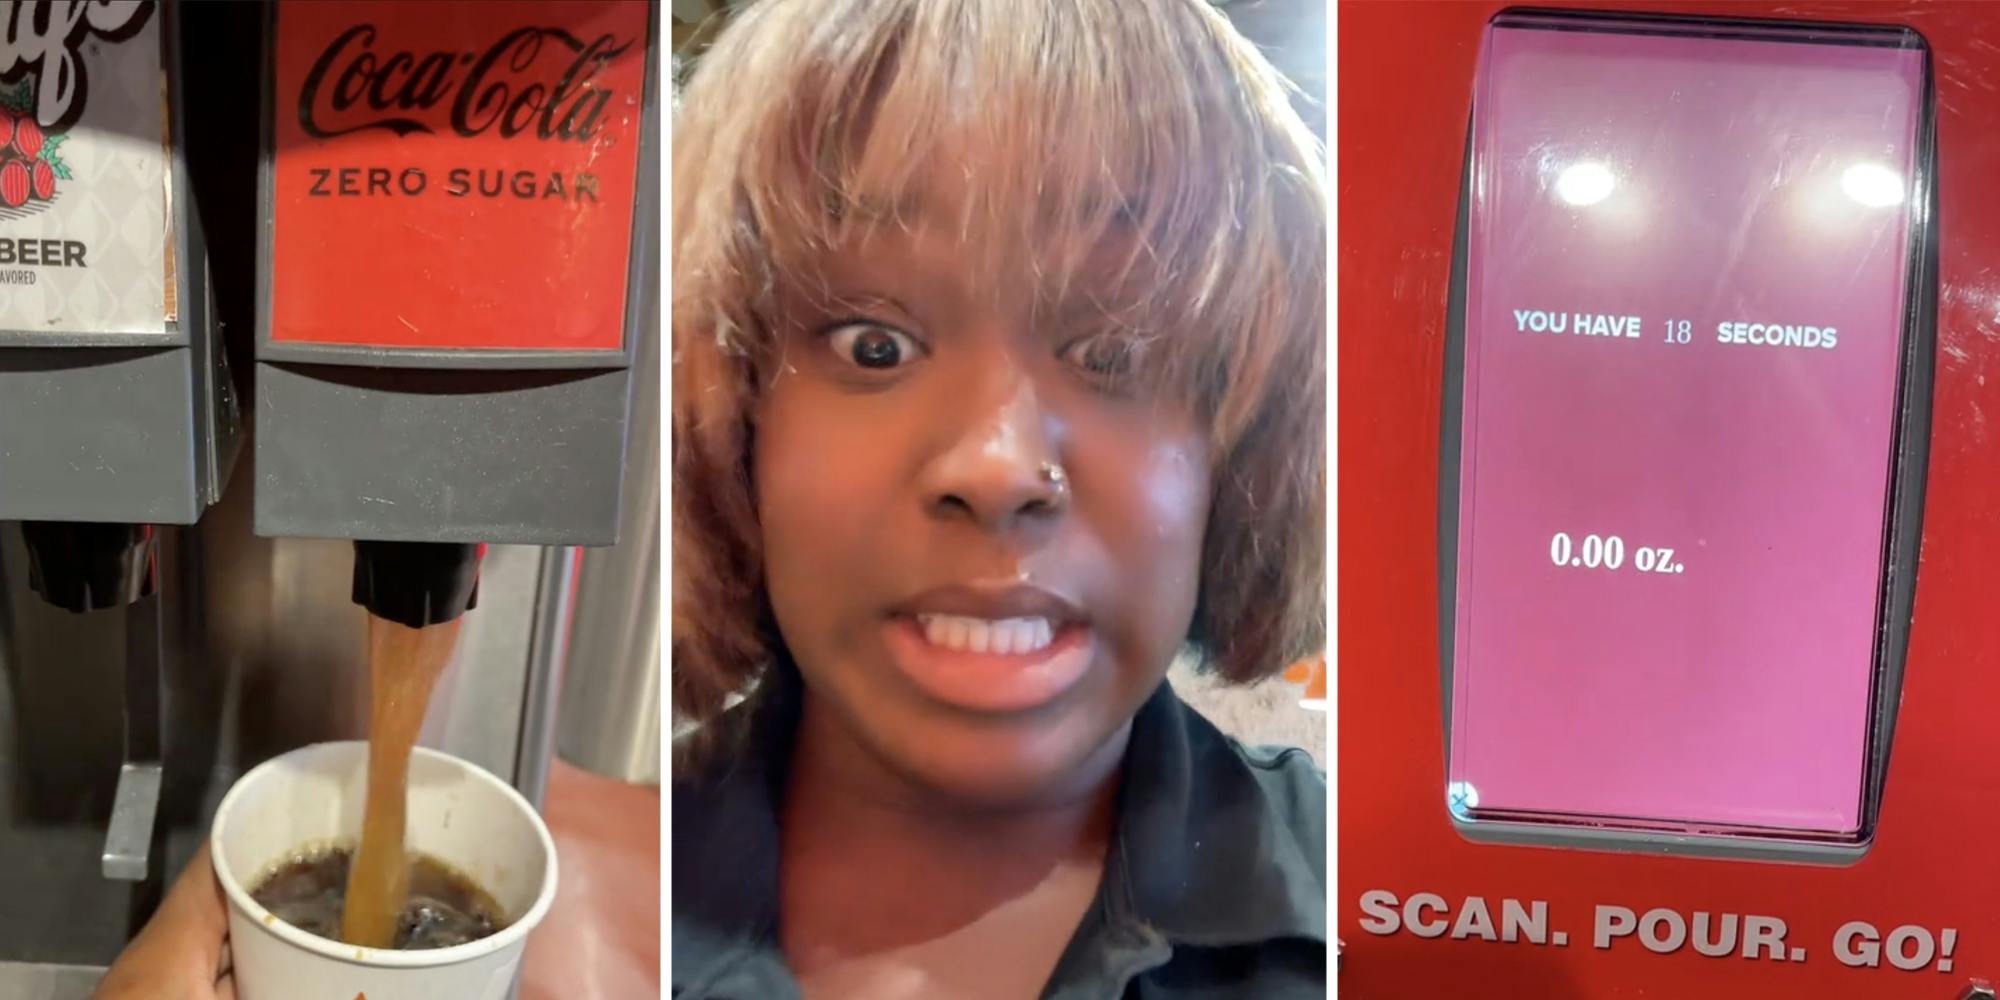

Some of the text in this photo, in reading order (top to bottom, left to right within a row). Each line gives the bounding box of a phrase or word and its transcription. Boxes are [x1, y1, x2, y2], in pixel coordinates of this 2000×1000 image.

[298, 24, 636, 142] Coca-Cola
[309, 167, 600, 204] ZERO SUGAR
[0, 237, 87, 268] BEER
[1513, 309, 1838, 349] YOU HAVE 18 SECONDS
[1550, 532, 1685, 574] 0.00 oz.
[1358, 889, 1957, 973] SCAN. POUR. GO!
